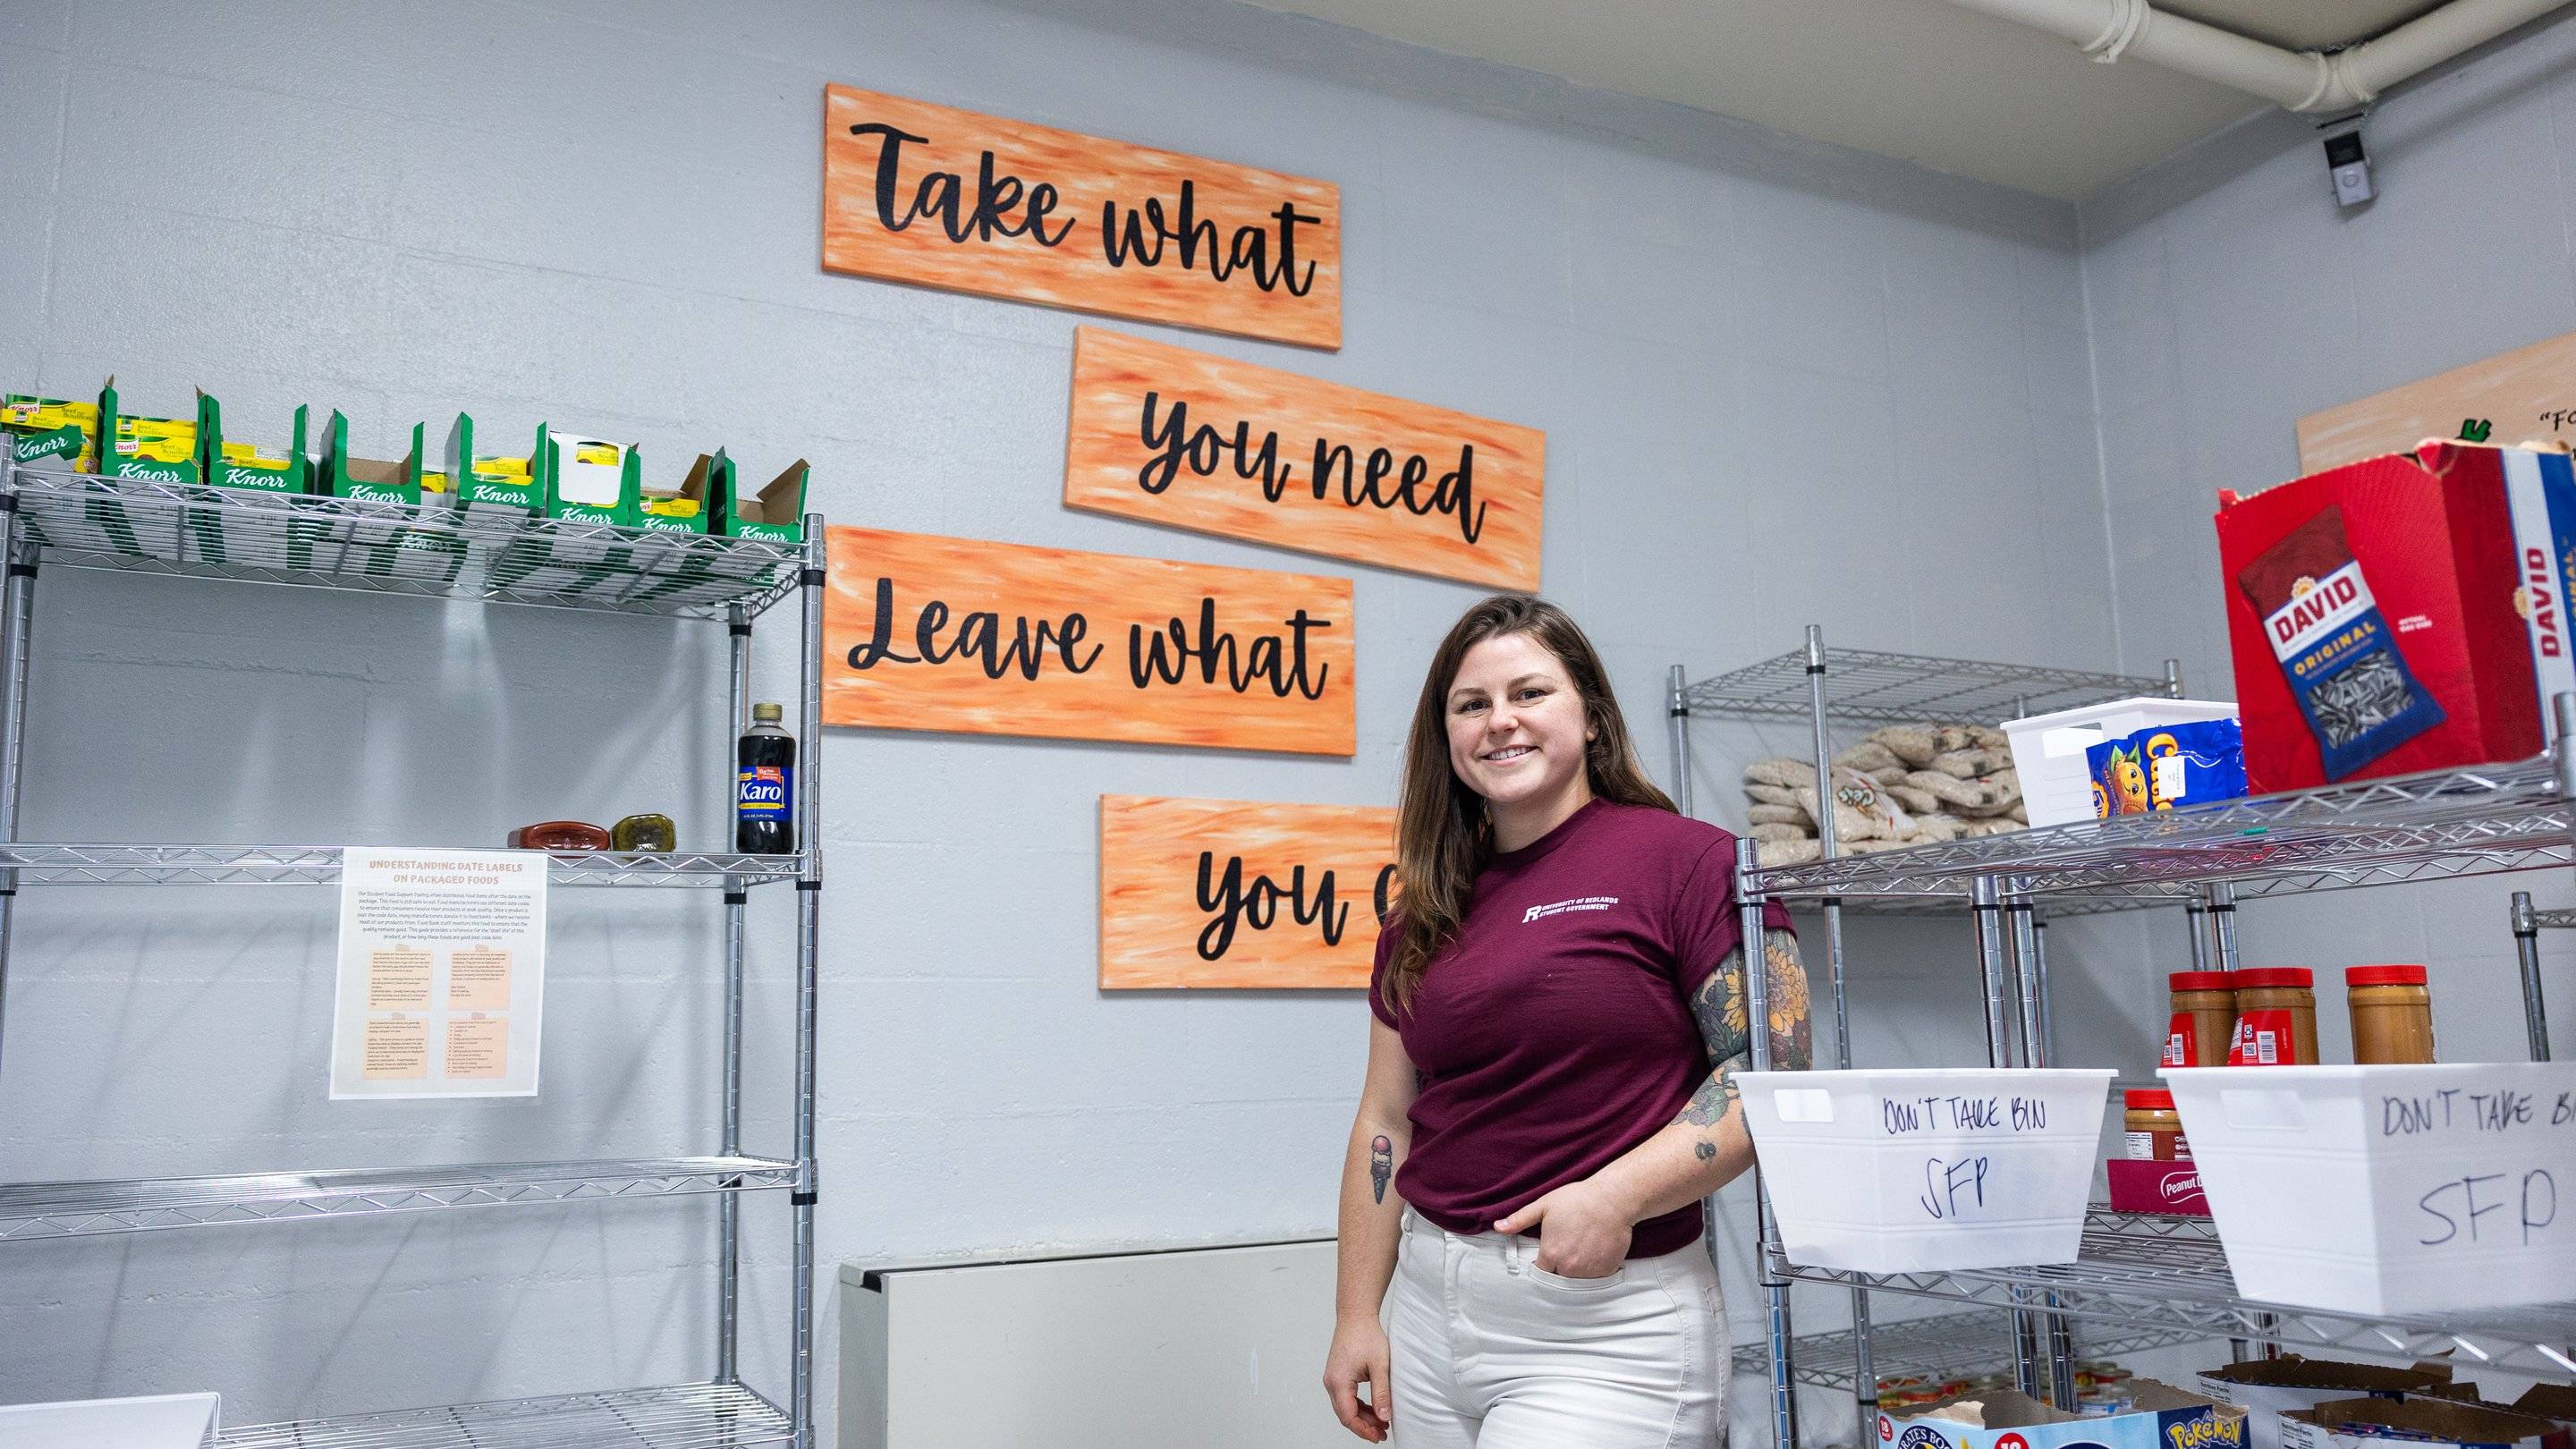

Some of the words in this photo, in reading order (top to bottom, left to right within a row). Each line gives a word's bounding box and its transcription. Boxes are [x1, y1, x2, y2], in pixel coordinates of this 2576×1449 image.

[850, 123, 1076, 247] Take
[1102, 179, 1321, 297] what
[16, 436, 69, 459] Knorr
[117, 462, 182, 483] Knorr
[225, 468, 288, 488] Knorr
[1138, 391, 1292, 503] you
[1311, 437, 1487, 545] need
[348, 484, 407, 504] Knorr
[473, 485, 530, 504] Knorr
[560, 507, 614, 526] Knorr
[641, 517, 695, 534] Knorr
[738, 525, 789, 543] Knorr
[2273, 575, 2358, 645] DAVID
[2526, 547, 2562, 658] DAVID
[847, 577, 1104, 681] Leave
[1129, 597, 1331, 700] what
[2293, 620, 2377, 676] ORIGINAL
[740, 782, 782, 801] Karo
[369, 860, 456, 870] UNDERSTANDING
[458, 862, 484, 871] DATE
[486, 863, 523, 872] LABELS
[394, 875, 408, 883] ON
[411, 875, 464, 884] PACKAGED
[468, 876, 500, 885] FOODS
[1197, 851, 1349, 962] you
[1538, 907, 1566, 918] STUDENT
[1566, 903, 1610, 912] GOVERNMENT
[1542, 899, 1576, 911] UNIVERSITY
[1585, 896, 1619, 904] REDLANDS
[1883, 1097, 1939, 1134] DON'T
[2012, 1097, 2046, 1131] BIN
[2384, 1089, 2462, 1136] DON'T
[1921, 1157, 1988, 1219] SFP
[2166, 1177, 2196, 1197] Peanut
[2419, 1168, 2557, 1247] SFP
